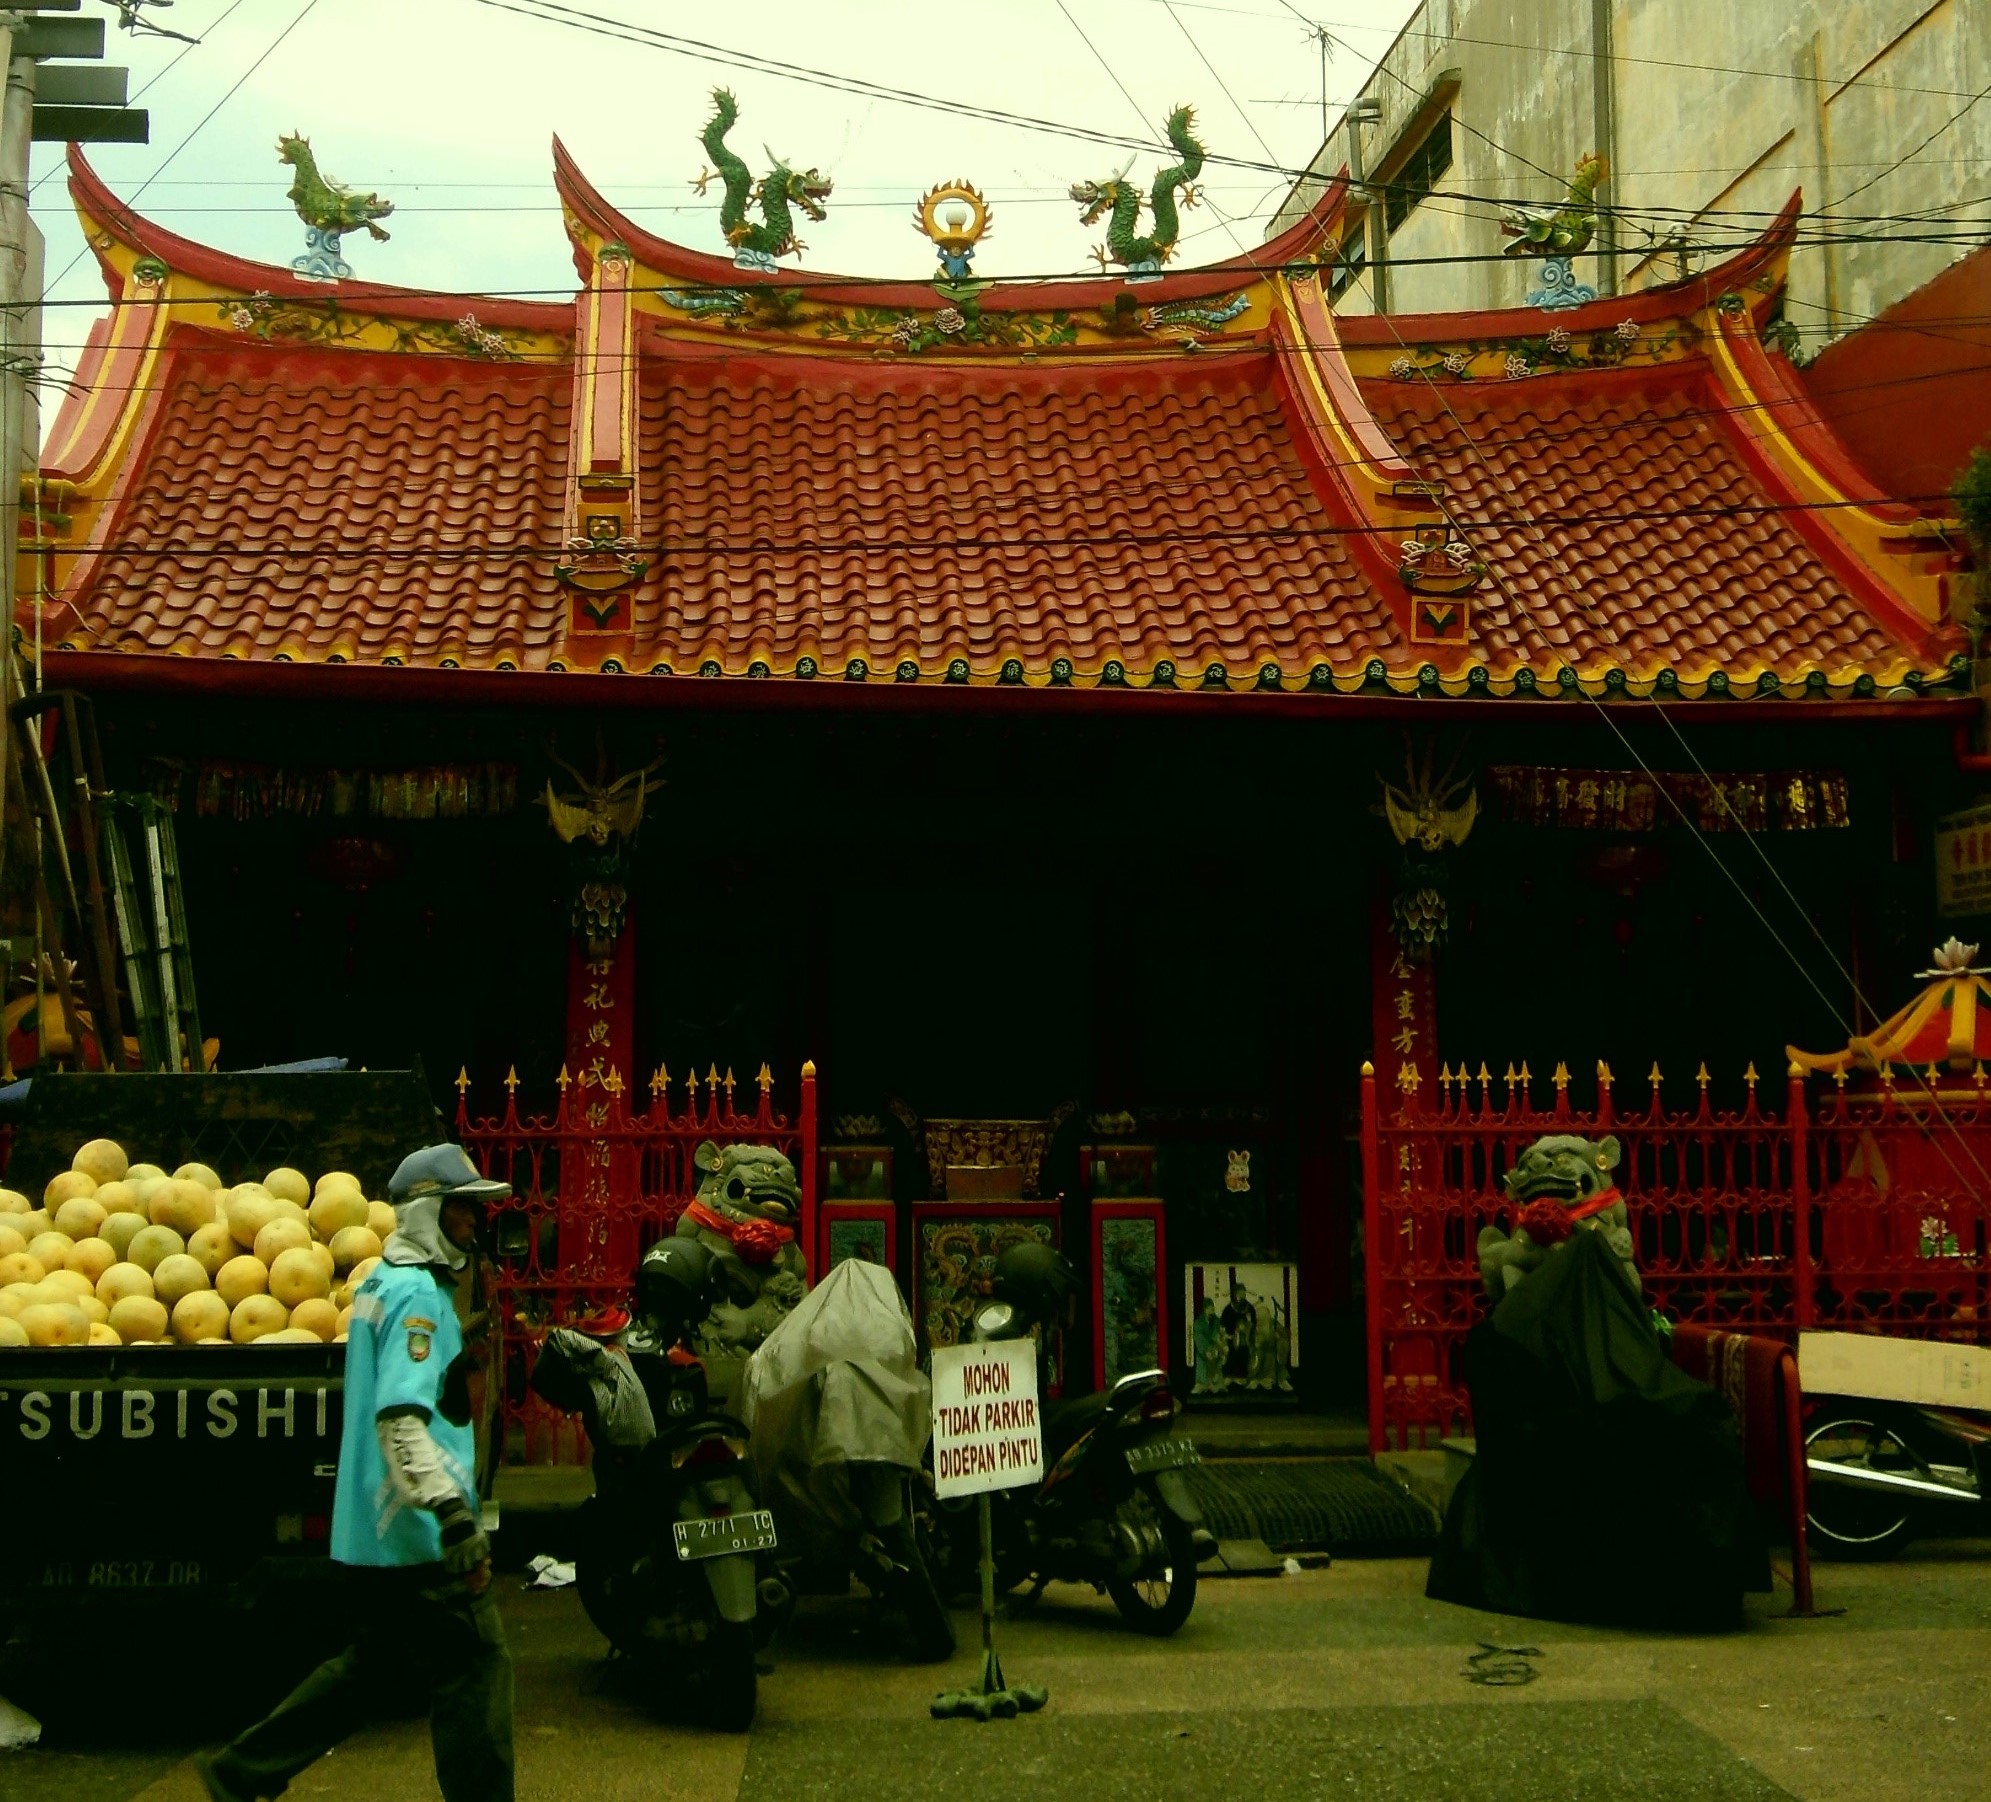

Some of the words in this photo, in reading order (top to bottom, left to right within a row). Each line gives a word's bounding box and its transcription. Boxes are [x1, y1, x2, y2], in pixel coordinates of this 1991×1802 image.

[963, 1362, 1010, 1397] MOHON
[0, 1388, 327, 1440] SUBISHI
[939, 1404, 980, 1438] TIDAK
[985, 1398, 1035, 1432] PARKIR
[940, 1443, 995, 1479] DIDEPAN
[999, 1438, 1038, 1470] PINTU
[677, 1524, 687, 1541] H
